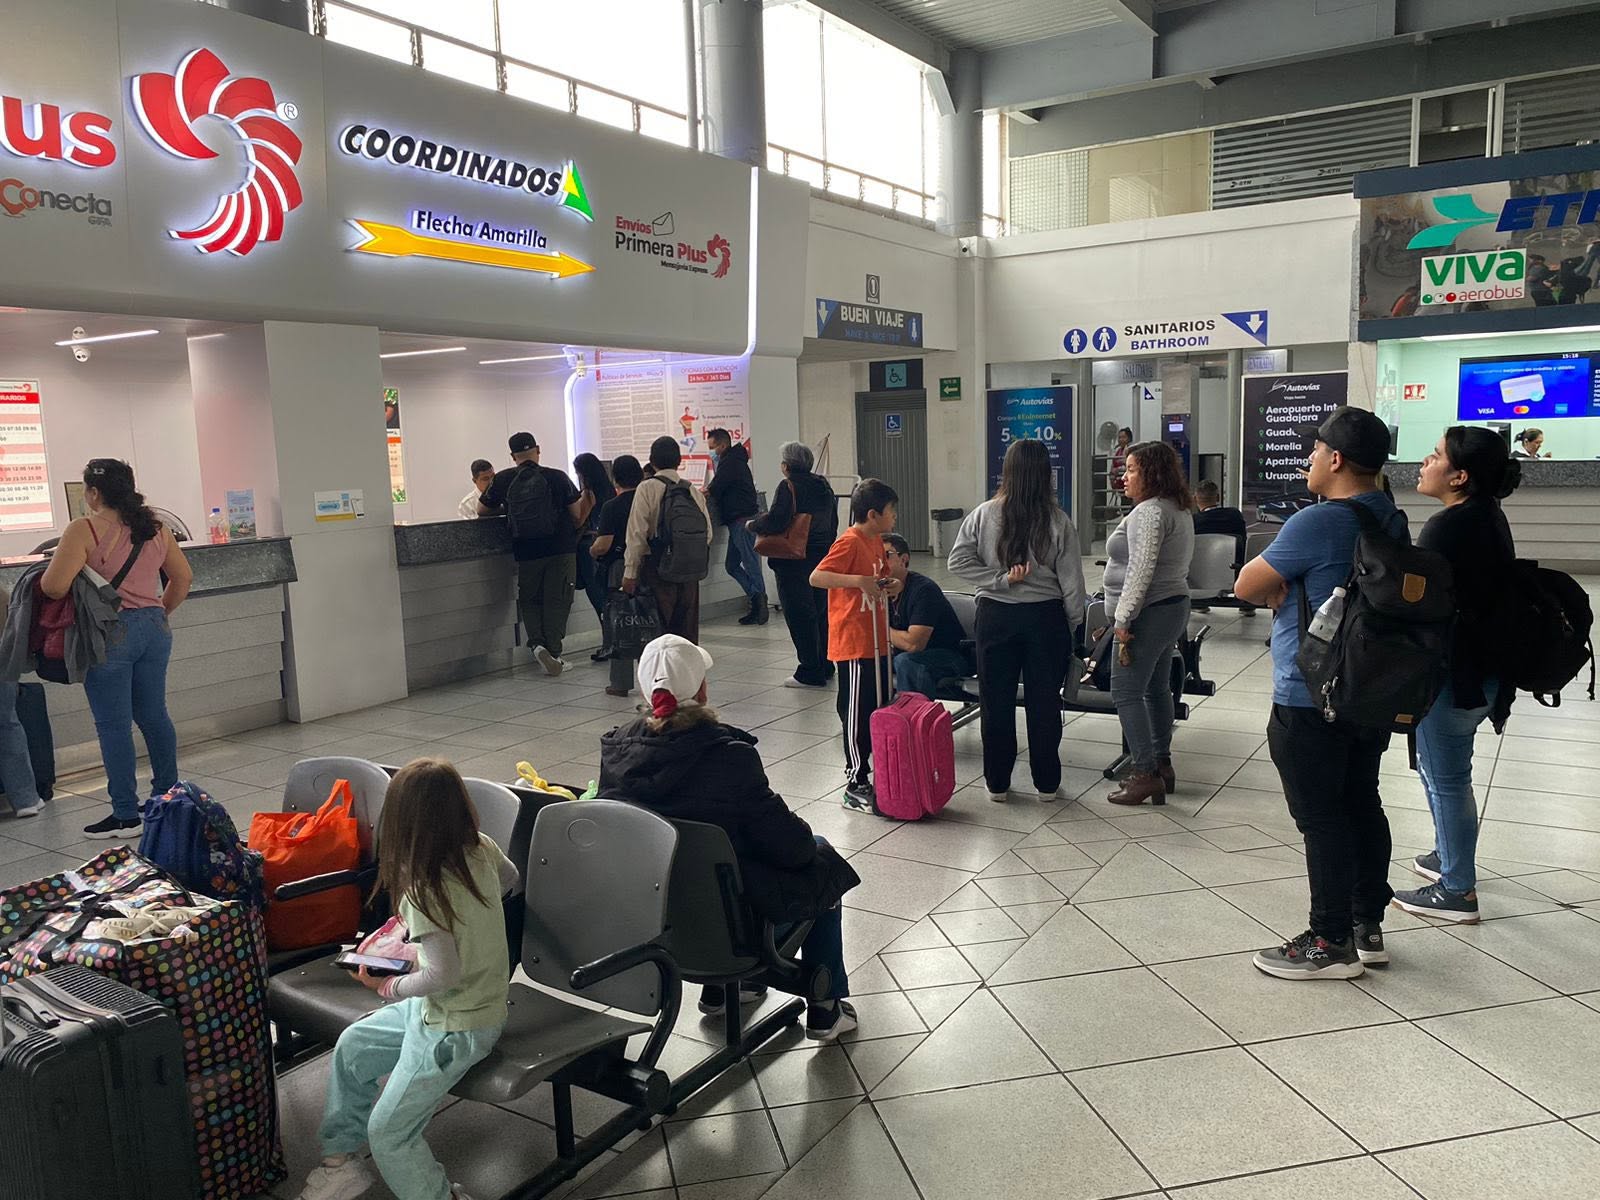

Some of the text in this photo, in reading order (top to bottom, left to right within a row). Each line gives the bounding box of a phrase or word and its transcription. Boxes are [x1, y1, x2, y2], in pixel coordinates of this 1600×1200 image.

[0, 96, 116, 168] us
[341, 125, 563, 197] COORDINADOS
[0, 178, 113, 217] Conecta
[414, 210, 548, 249] Flecha Amarilla
[615, 215, 652, 235] Envíos
[615, 231, 708, 264] Primera Plus
[1459, 284, 1523, 302] aerobus
[840, 304, 904, 328] BUEN VIAJE
[1124, 320, 1216, 336] SANITARIOS
[1130, 336, 1209, 350] BATHROOM
[1287, 383, 1321, 392] Autovías
[1020, 397, 1054, 406] Autovías
[1265, 404, 1321, 418] Aeropuerto
[1265, 442, 1302, 451] Morelia
[1265, 457, 1309, 467] Apatzing
